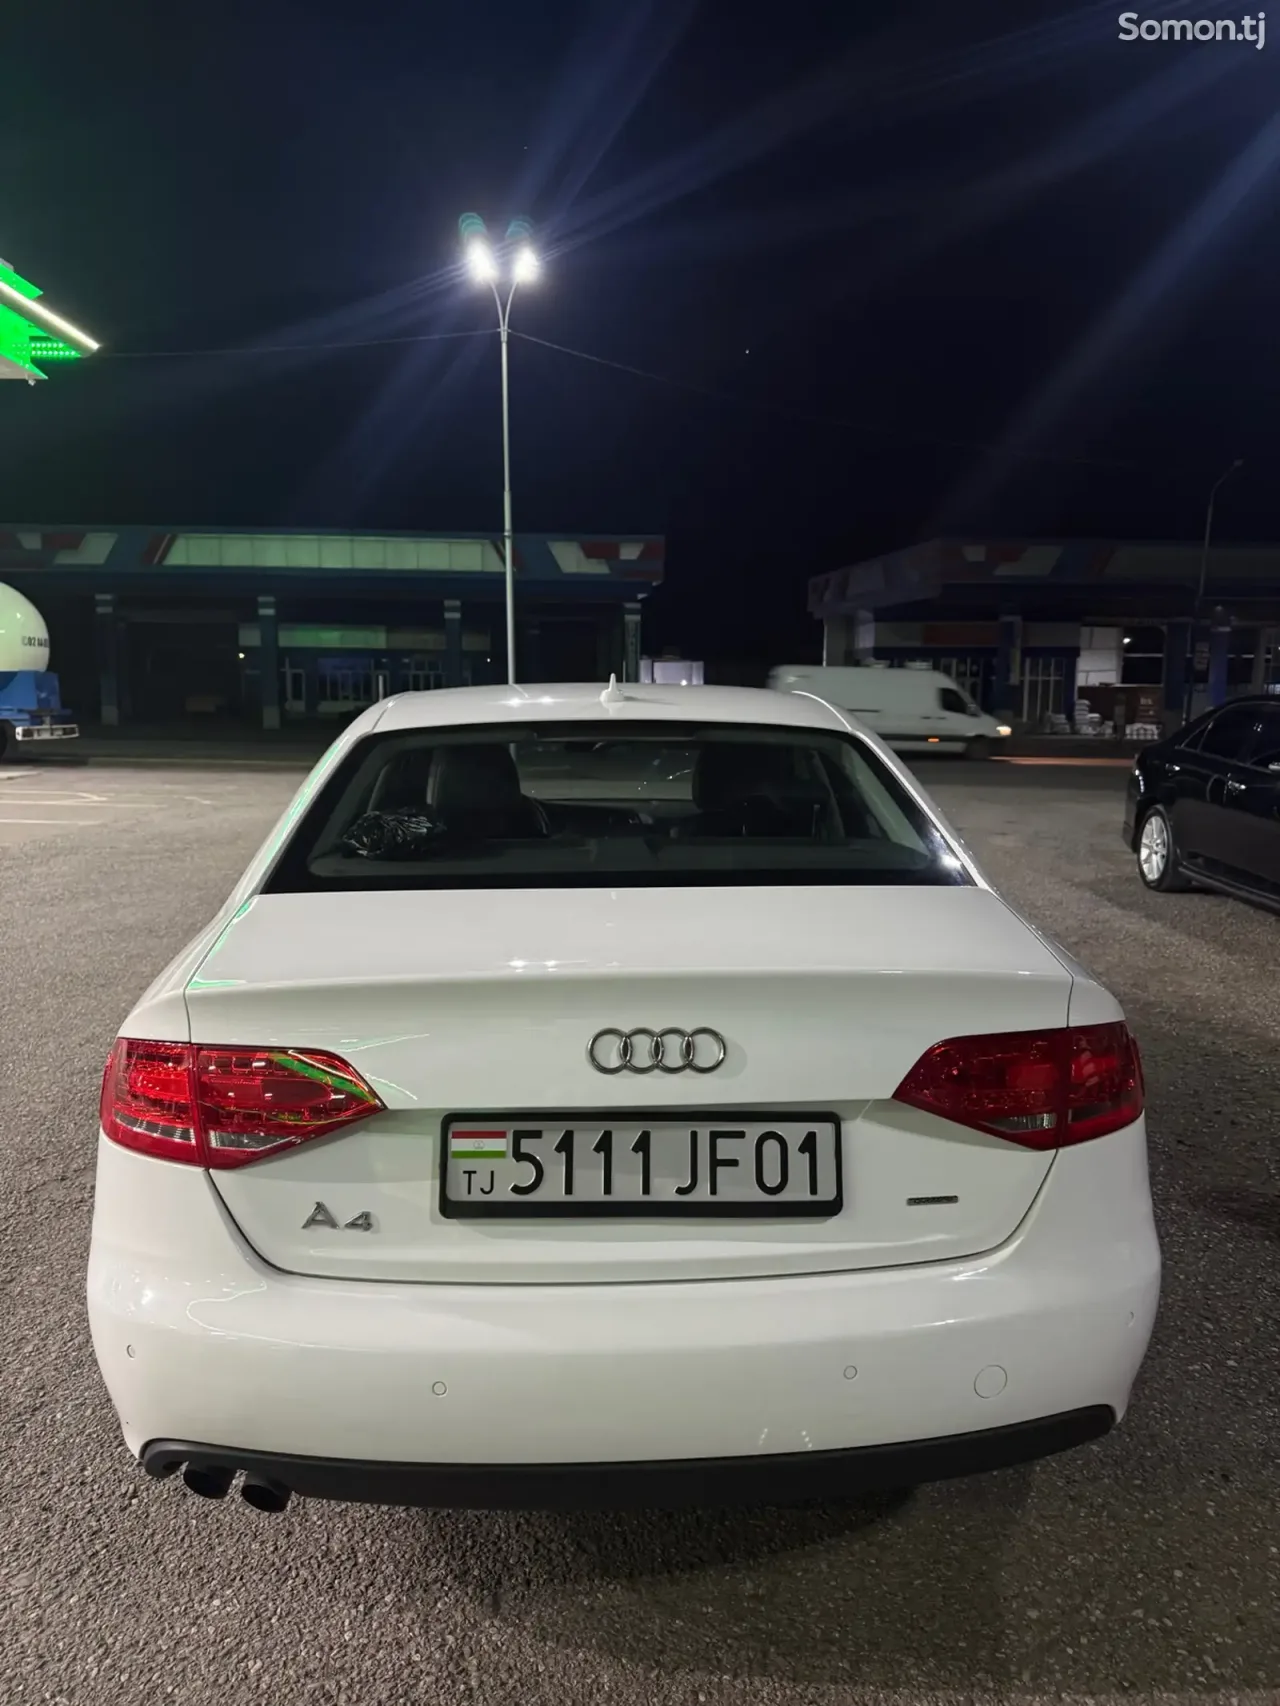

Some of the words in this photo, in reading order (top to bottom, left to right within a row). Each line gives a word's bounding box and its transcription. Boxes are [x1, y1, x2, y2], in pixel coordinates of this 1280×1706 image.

[509, 1130, 651, 1196] 5111
[462, 1170, 495, 1196] TJ
[300, 1201, 374, 1232] A4
